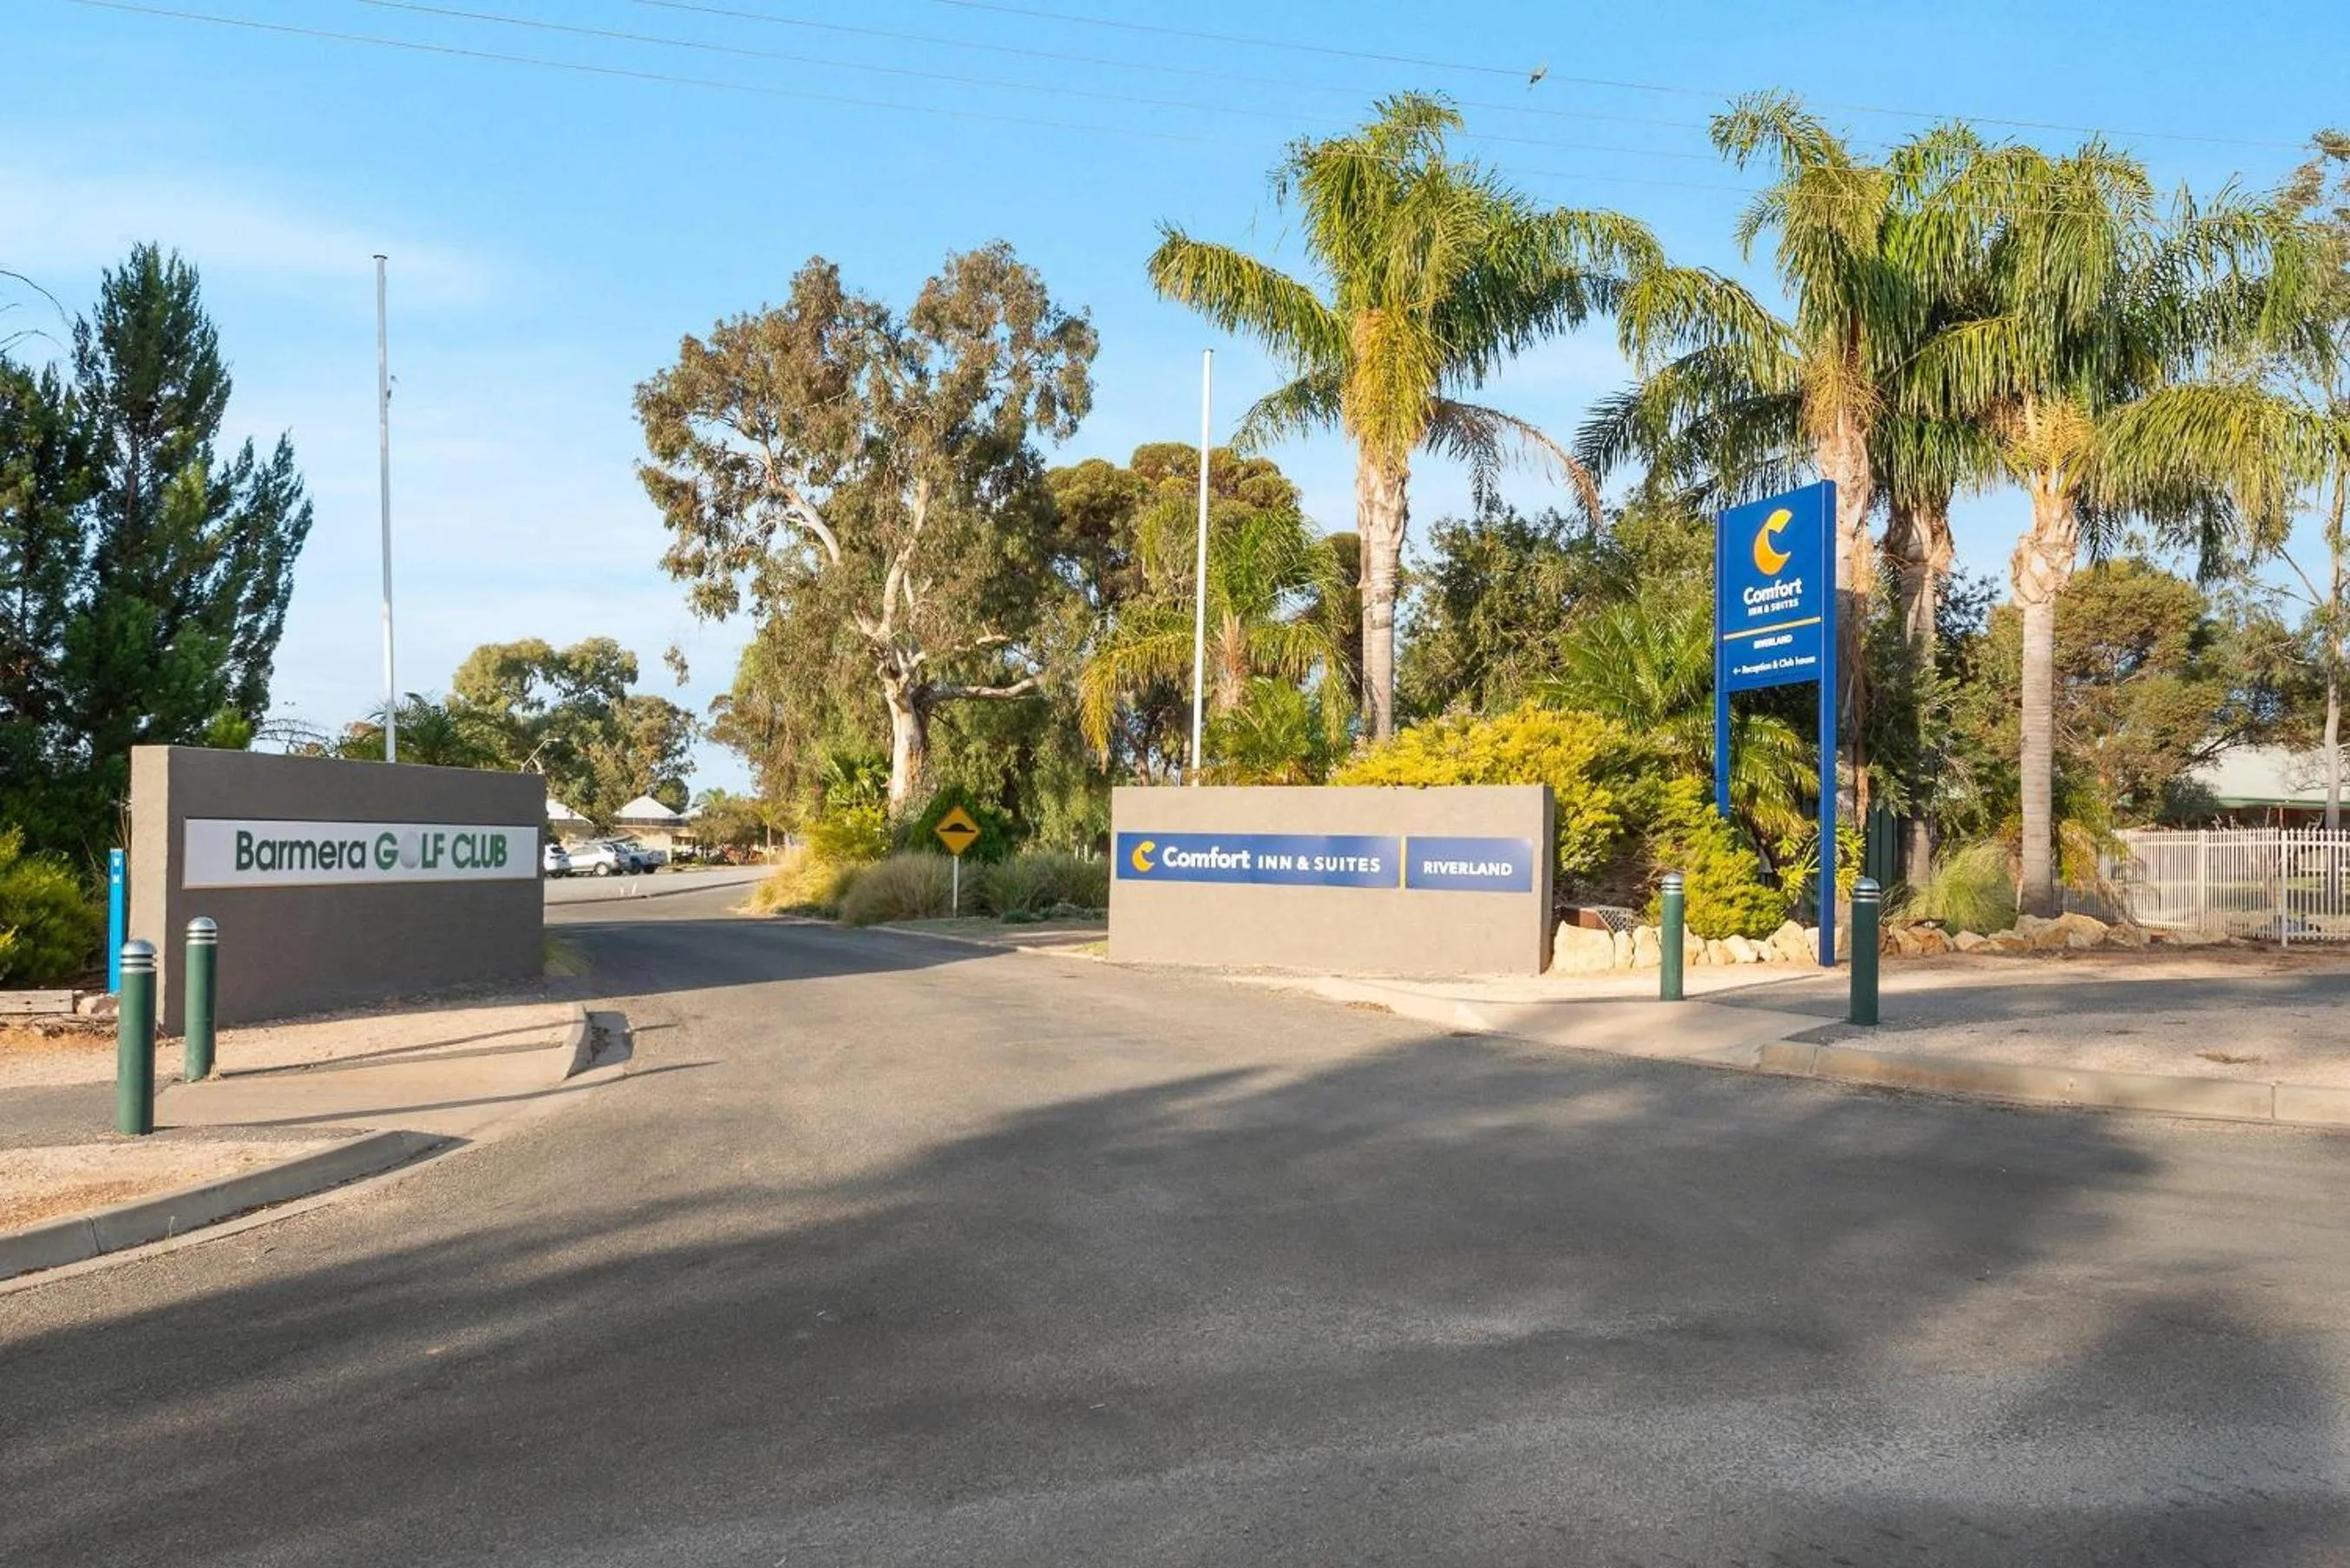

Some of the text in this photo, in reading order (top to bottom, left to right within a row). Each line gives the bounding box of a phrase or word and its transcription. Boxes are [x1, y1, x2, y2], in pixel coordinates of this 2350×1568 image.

[1743, 578, 1803, 605] Comfort
[235, 829, 366, 871] Barmera
[451, 832, 508, 868] CLUB
[1162, 846, 1382, 873] Comfort INN & SUITES
[1423, 860, 1513, 876] RIVERLAND
